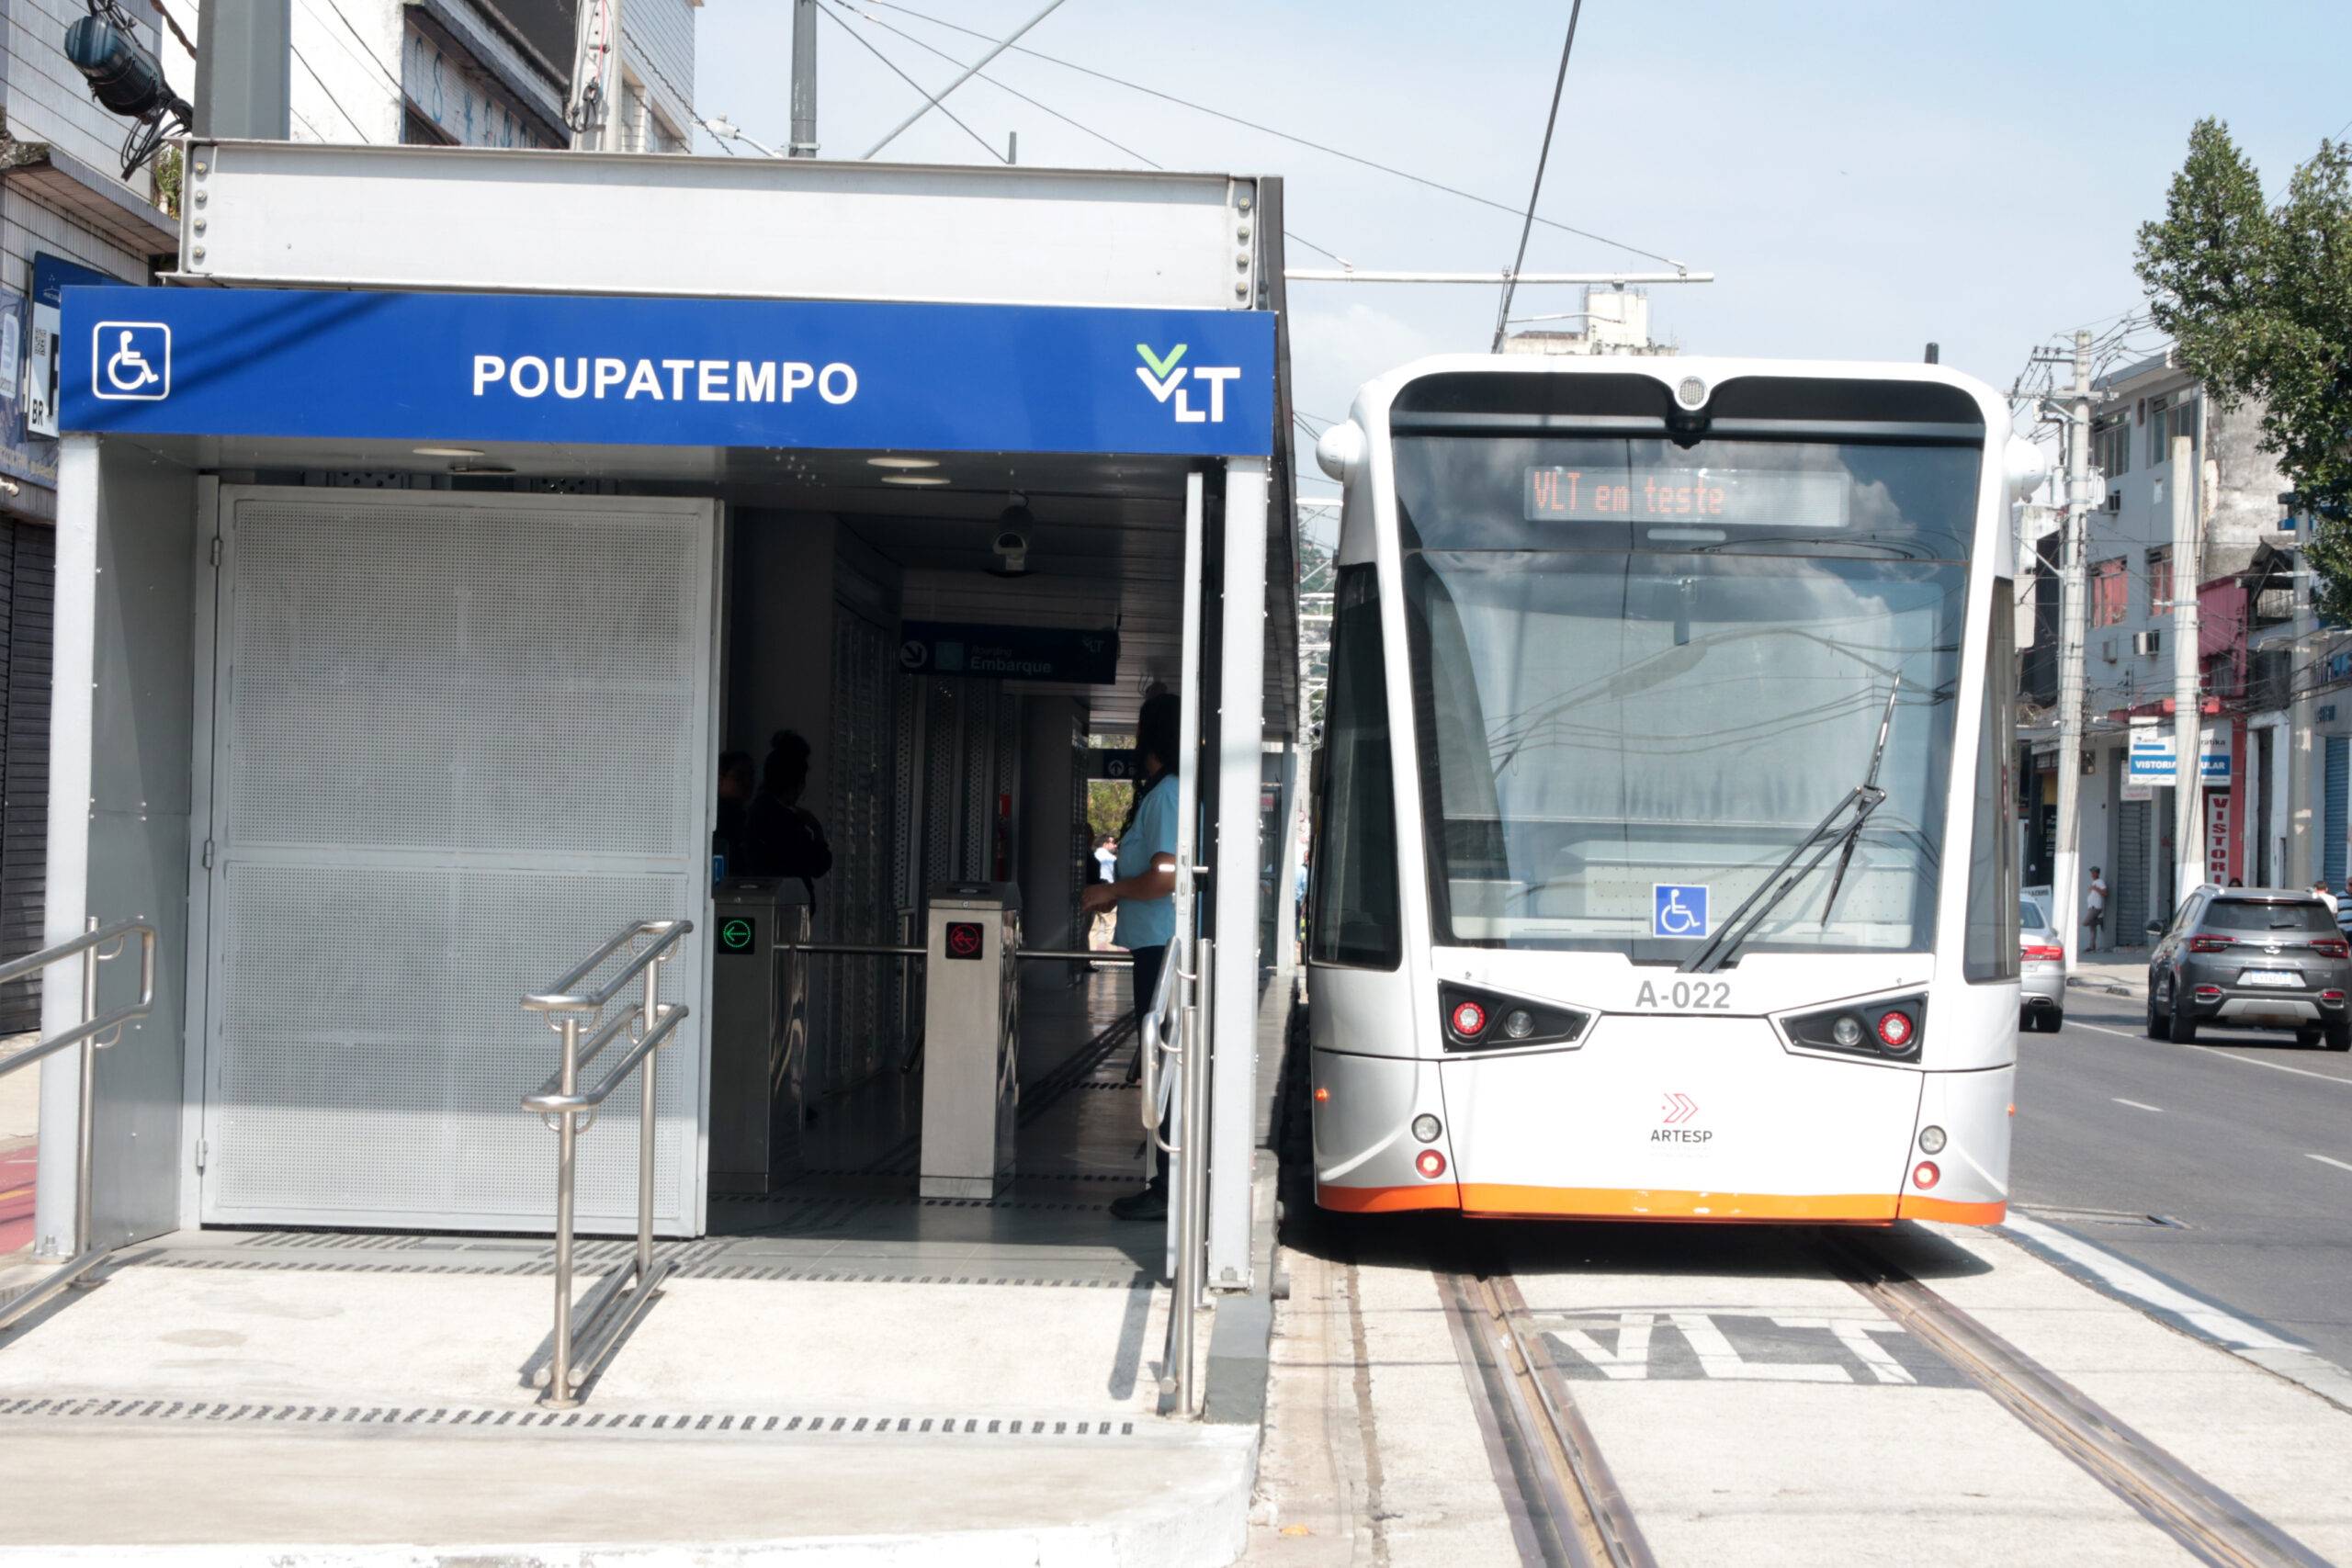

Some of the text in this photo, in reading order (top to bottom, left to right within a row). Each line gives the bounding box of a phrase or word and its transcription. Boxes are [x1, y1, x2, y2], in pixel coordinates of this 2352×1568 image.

[473, 355, 858, 405] POUPATEMPO
[1136, 344, 1241, 423] VLT
[32, 399, 44, 426] BR
[1533, 470, 1726, 515] VLT em teste
[970, 656, 1053, 675] Embarque
[2211, 797, 2229, 885] VISTORI
[1635, 979, 1731, 1009] A-022
[1650, 1129, 1713, 1143] ARTESP
